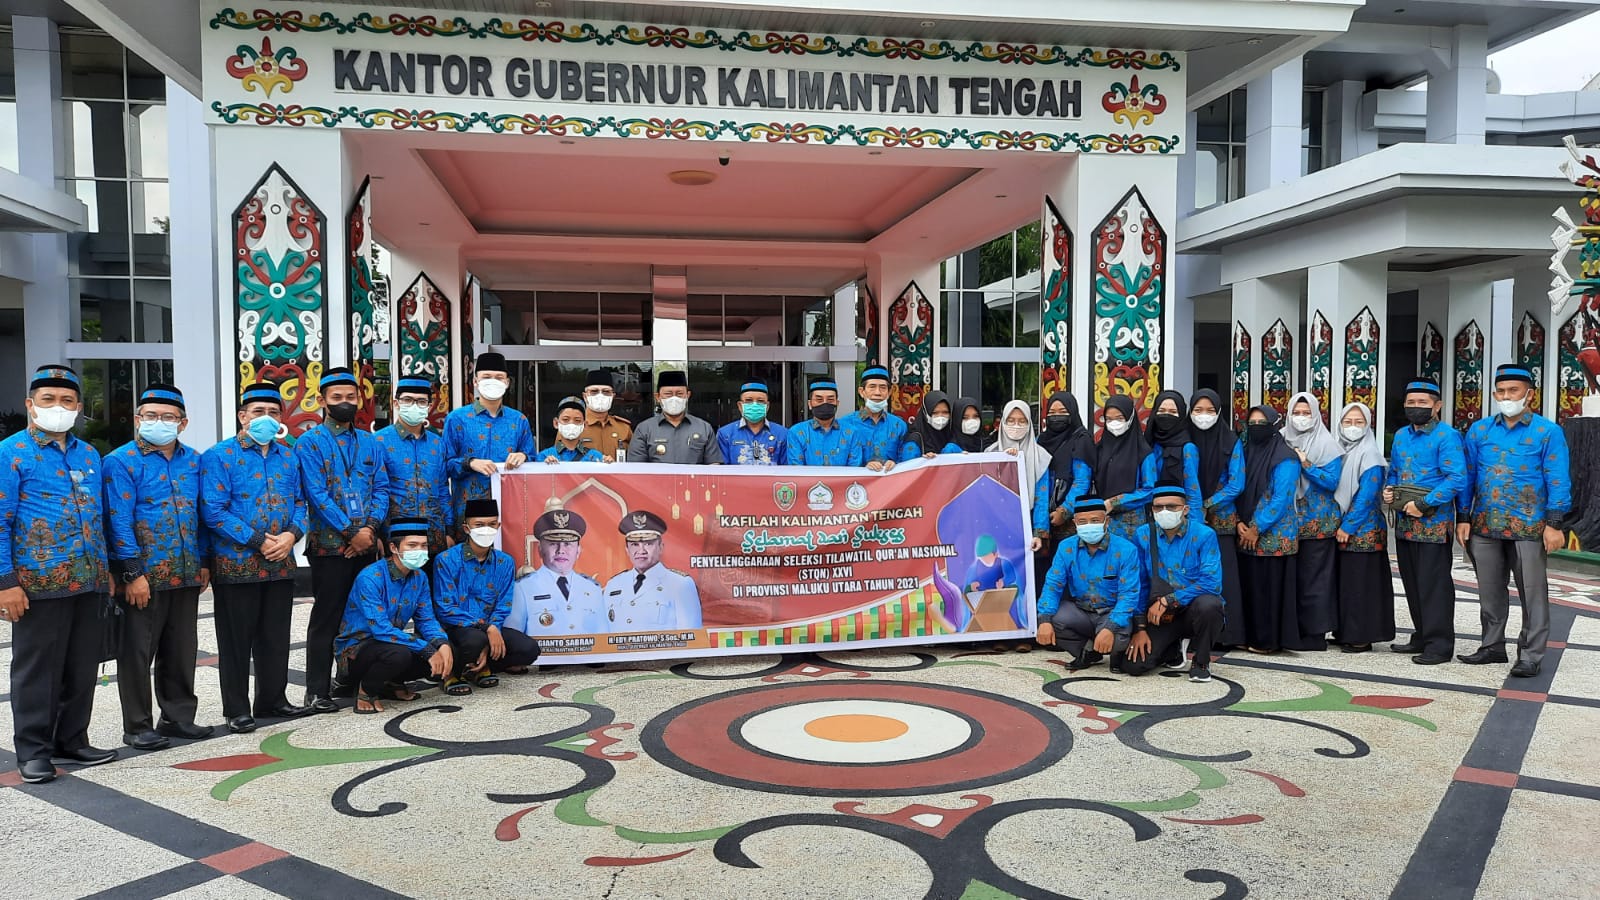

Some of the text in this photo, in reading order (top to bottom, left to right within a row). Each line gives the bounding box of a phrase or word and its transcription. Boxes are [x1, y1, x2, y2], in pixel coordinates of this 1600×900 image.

[334, 49, 1082, 117] KANTOR GUBERNUR KALIMANTAN TENGAH
[720, 507, 923, 528] KAFILAH KALIMANTAN TENGAH
[741, 524, 905, 553] Selamat dan Sukses
[690, 545, 957, 568] PENYELENGGARAAN SELEKSI TILAWATIL QUR'AN NASIONAL
[798, 566, 853, 581] (STQN) XXVI
[733, 577, 919, 598] DI PROVINSI MALUKU UTARA TAHUN 2021
[537, 639, 564, 647] GIANTO
